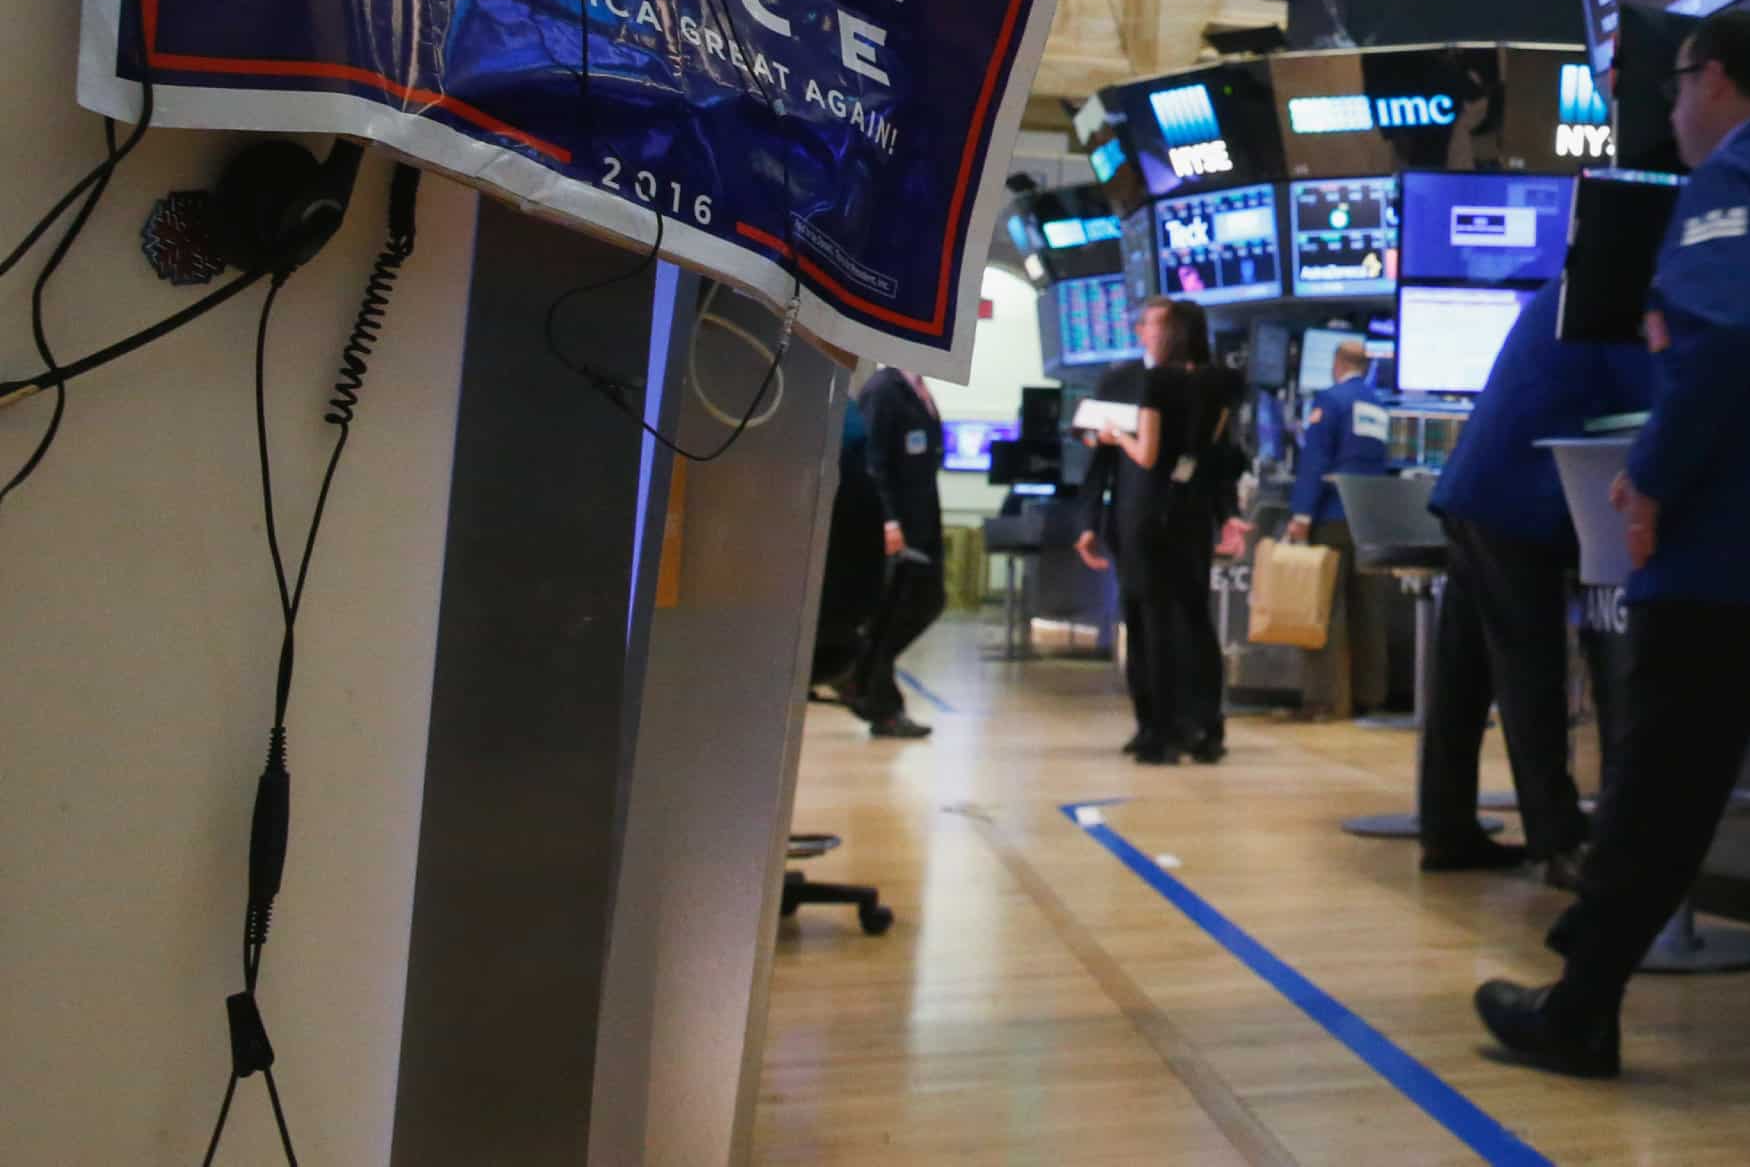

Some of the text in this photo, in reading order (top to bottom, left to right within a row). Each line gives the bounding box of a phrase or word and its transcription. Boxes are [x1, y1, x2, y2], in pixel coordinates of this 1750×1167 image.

[680, 15, 790, 90] GREAT
[804, 79, 899, 156] AGAIN!
[1376, 94, 1455, 127] imc
[1169, 140, 1233, 178] NYSE
[601, 156, 713, 225] 2016
